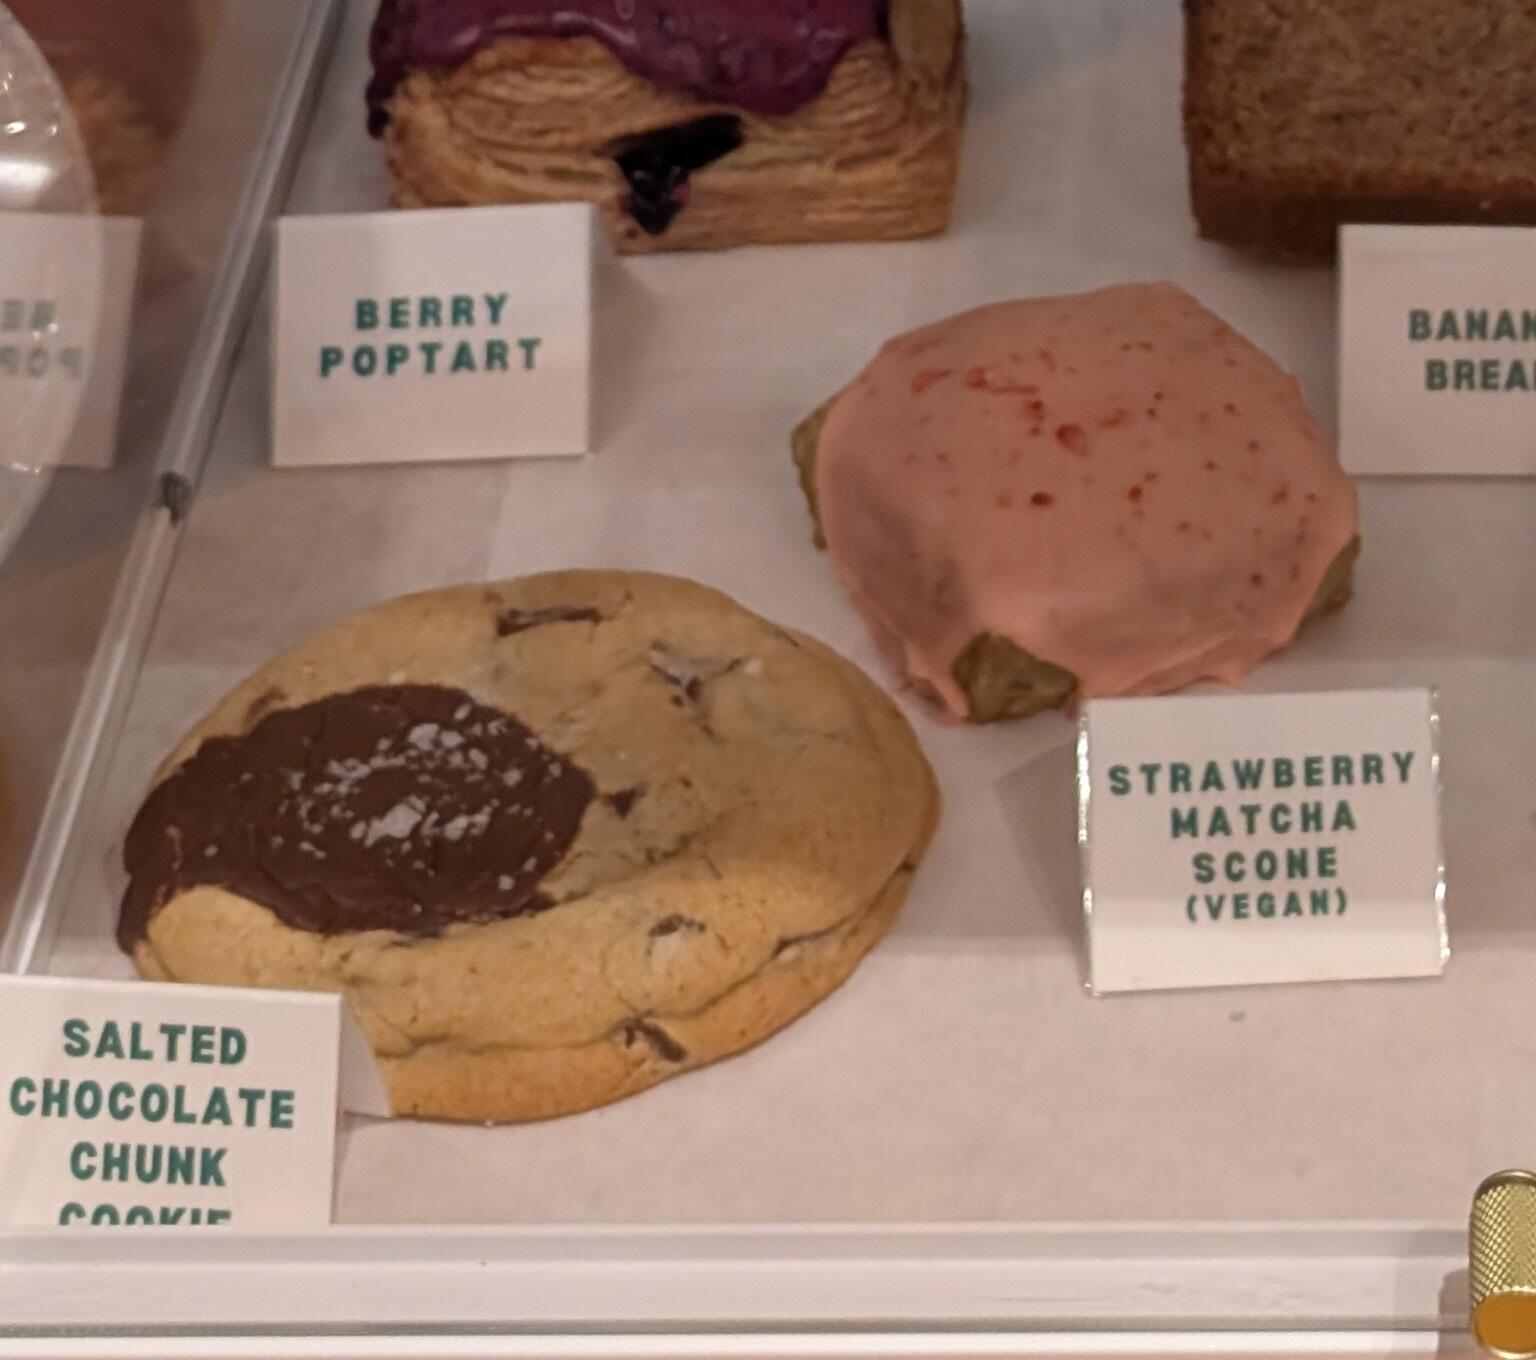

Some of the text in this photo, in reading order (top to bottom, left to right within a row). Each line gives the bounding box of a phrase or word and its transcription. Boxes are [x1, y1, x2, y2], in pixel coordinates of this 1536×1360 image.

[355, 294, 509, 330] BERRY
[320, 338, 542, 378] POPTART
[1108, 751, 1414, 796] STRAWBERRY
[1171, 801, 1356, 838] MATCHA
[1192, 847, 1338, 883] SCONE
[1186, 887, 1346, 922] (VEGAN)
[62, 1018, 247, 1065] SALTED
[10, 1077, 295, 1129] CHOCOLATE
[69, 1141, 228, 1187] CHUNK
